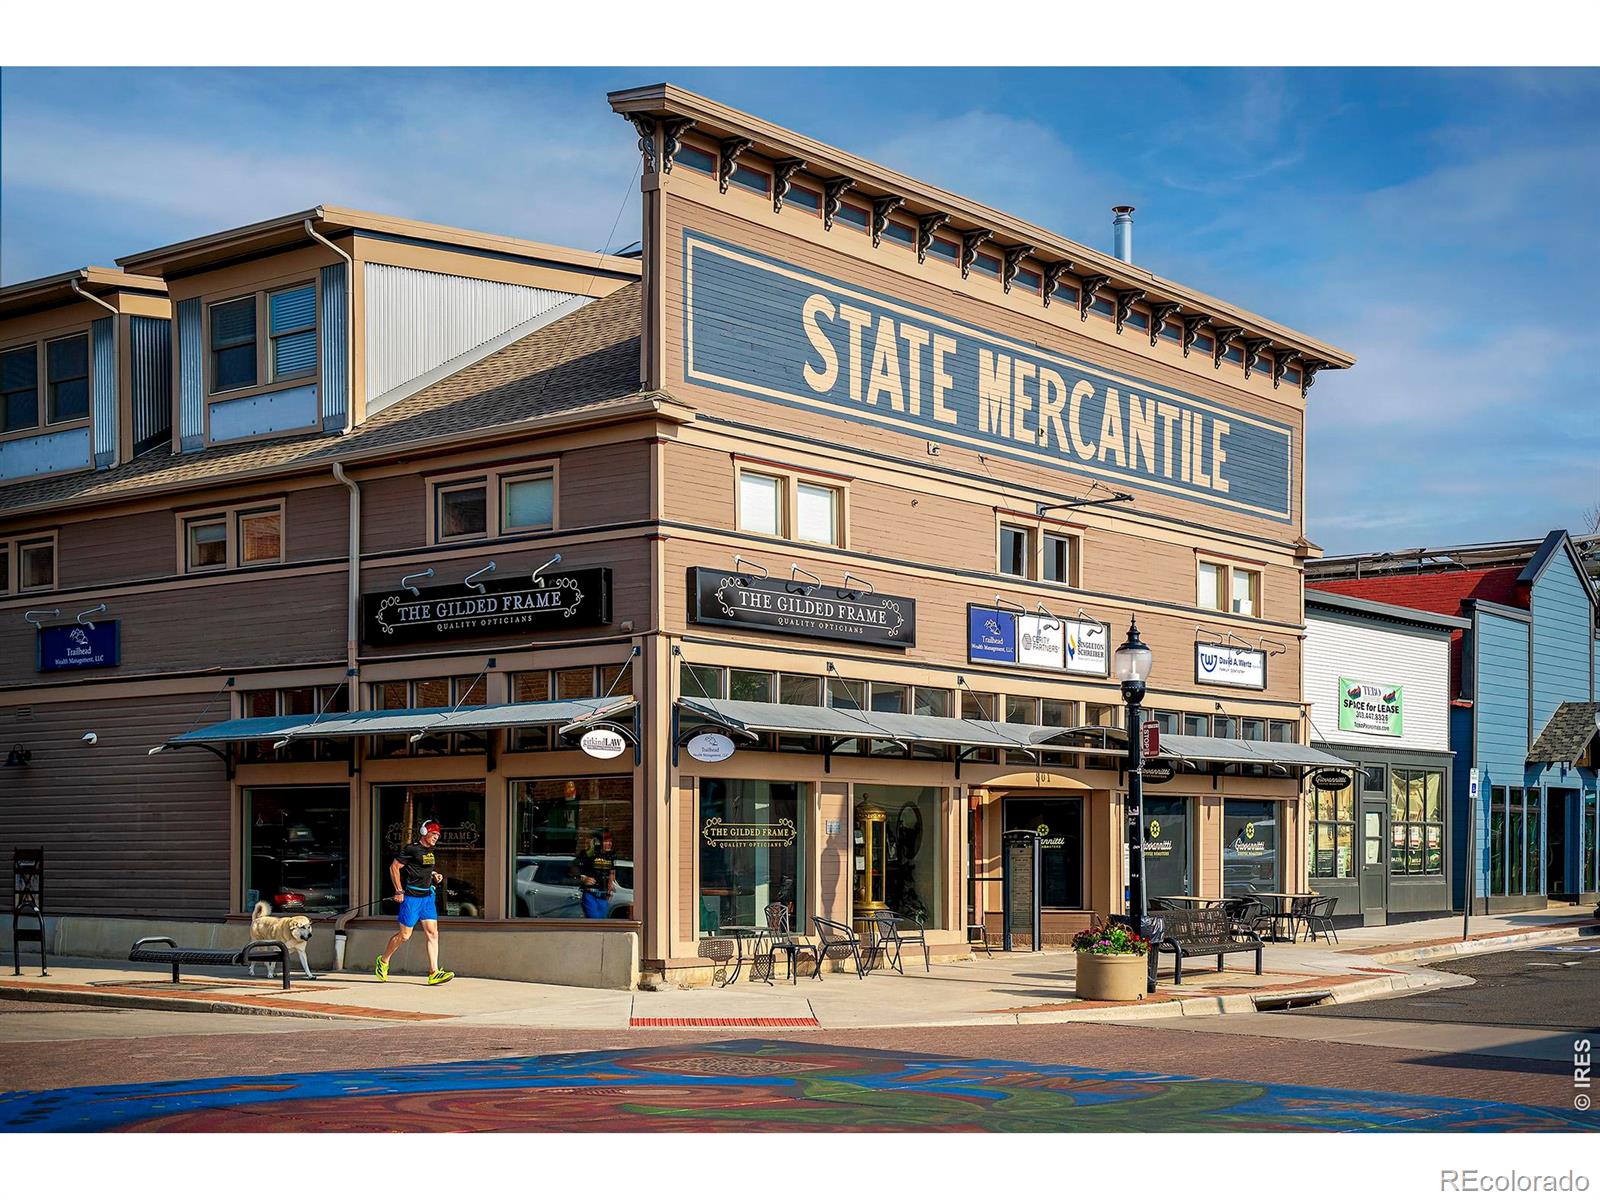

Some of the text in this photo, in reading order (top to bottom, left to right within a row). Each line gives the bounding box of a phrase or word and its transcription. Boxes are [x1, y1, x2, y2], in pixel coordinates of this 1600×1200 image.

[803, 293, 1231, 494] STATE MERCANTILE
[398, 591, 562, 622] THE GILDED FRAME
[738, 591, 888, 625] THE GILDED FRAME
[436, 614, 532, 632] QUALITY OPTICIANS
[777, 616, 864, 634] QUALITY OPTICIANS
[982, 635, 1004, 644] Trailhead
[66, 646, 92, 656] Trailhead
[1078, 648, 1104, 658] SCHREIBER
[1362, 685, 1382, 696] TEBO
[1344, 699, 1365, 711] SPACE
[1366, 702, 1376, 712] for
[1377, 704, 1399, 714] LEASE
[1035, 773, 1050, 782] 801
[710, 828, 789, 836] THE GILDED FRAME
